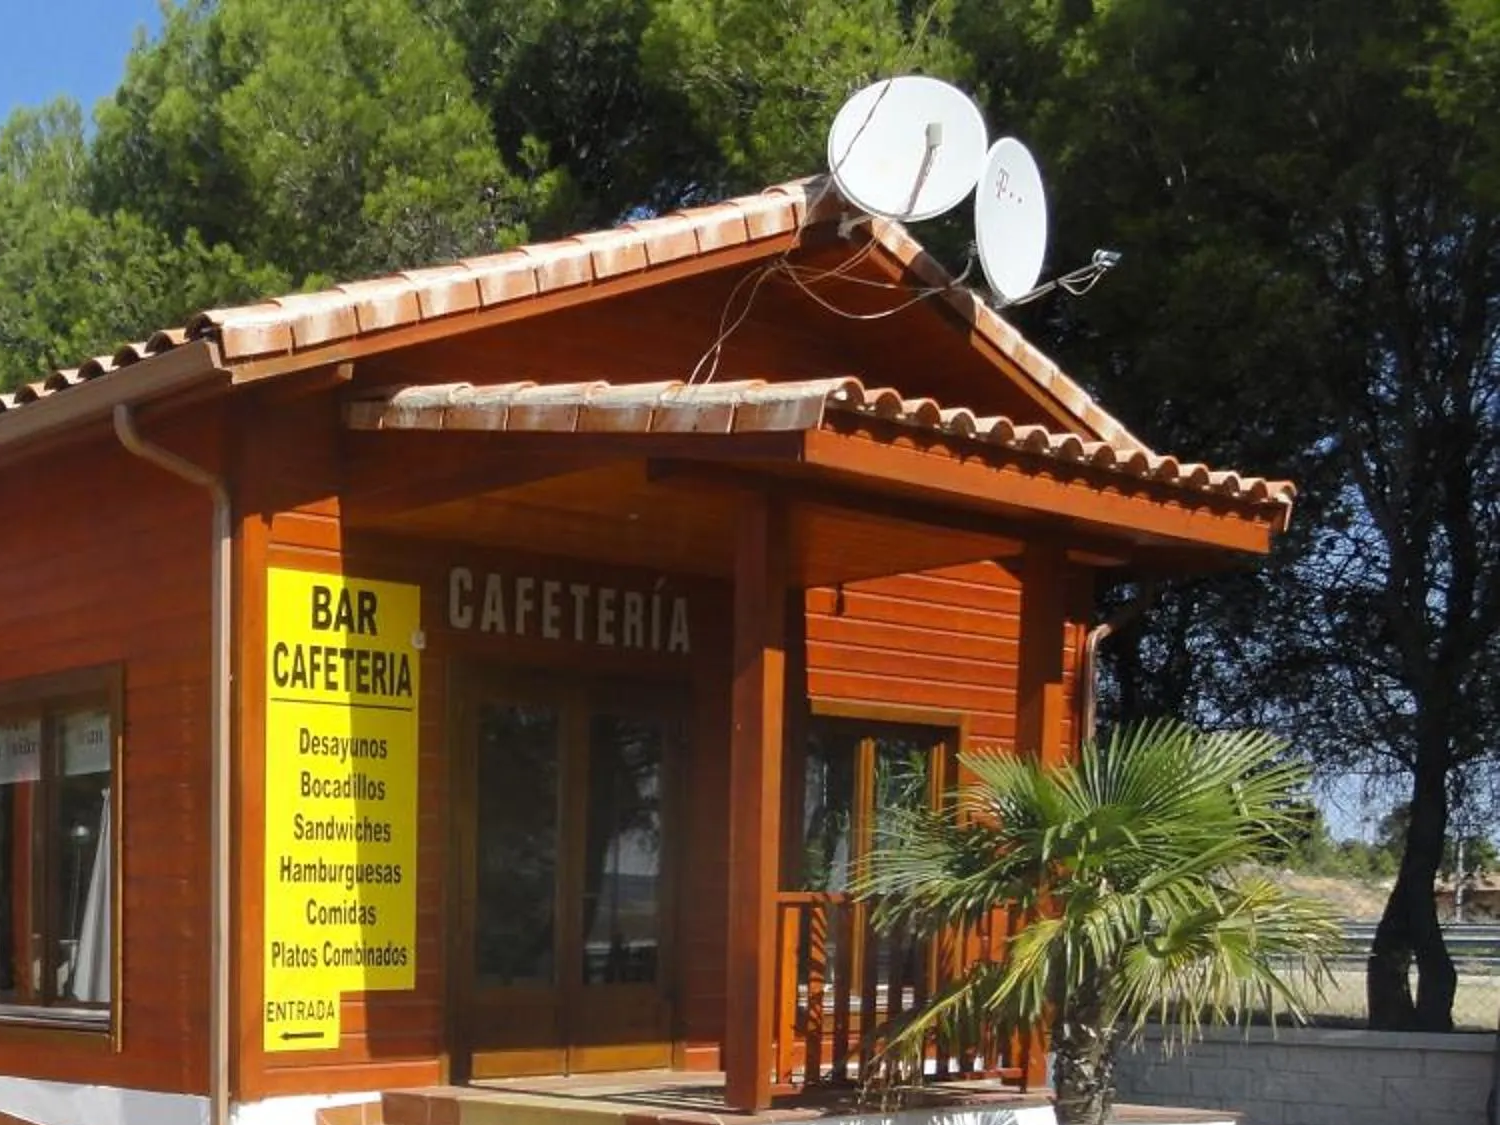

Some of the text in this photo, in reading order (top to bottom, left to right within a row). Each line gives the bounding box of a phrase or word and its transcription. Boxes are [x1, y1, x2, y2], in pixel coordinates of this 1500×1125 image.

[312, 585, 378, 636] BAR
[450, 566, 690, 654] CAFETERÍA
[273, 641, 412, 697] CAFETERIA
[299, 727, 388, 764] Desayunos
[300, 770, 386, 801] Bocadillos
[293, 813, 392, 843] Sandwiches
[279, 855, 403, 891] Hamburguesas
[306, 898, 378, 926] Comidas
[271, 940, 408, 967] Platos Combinados
[266, 1000, 335, 1023] ENTRADA
